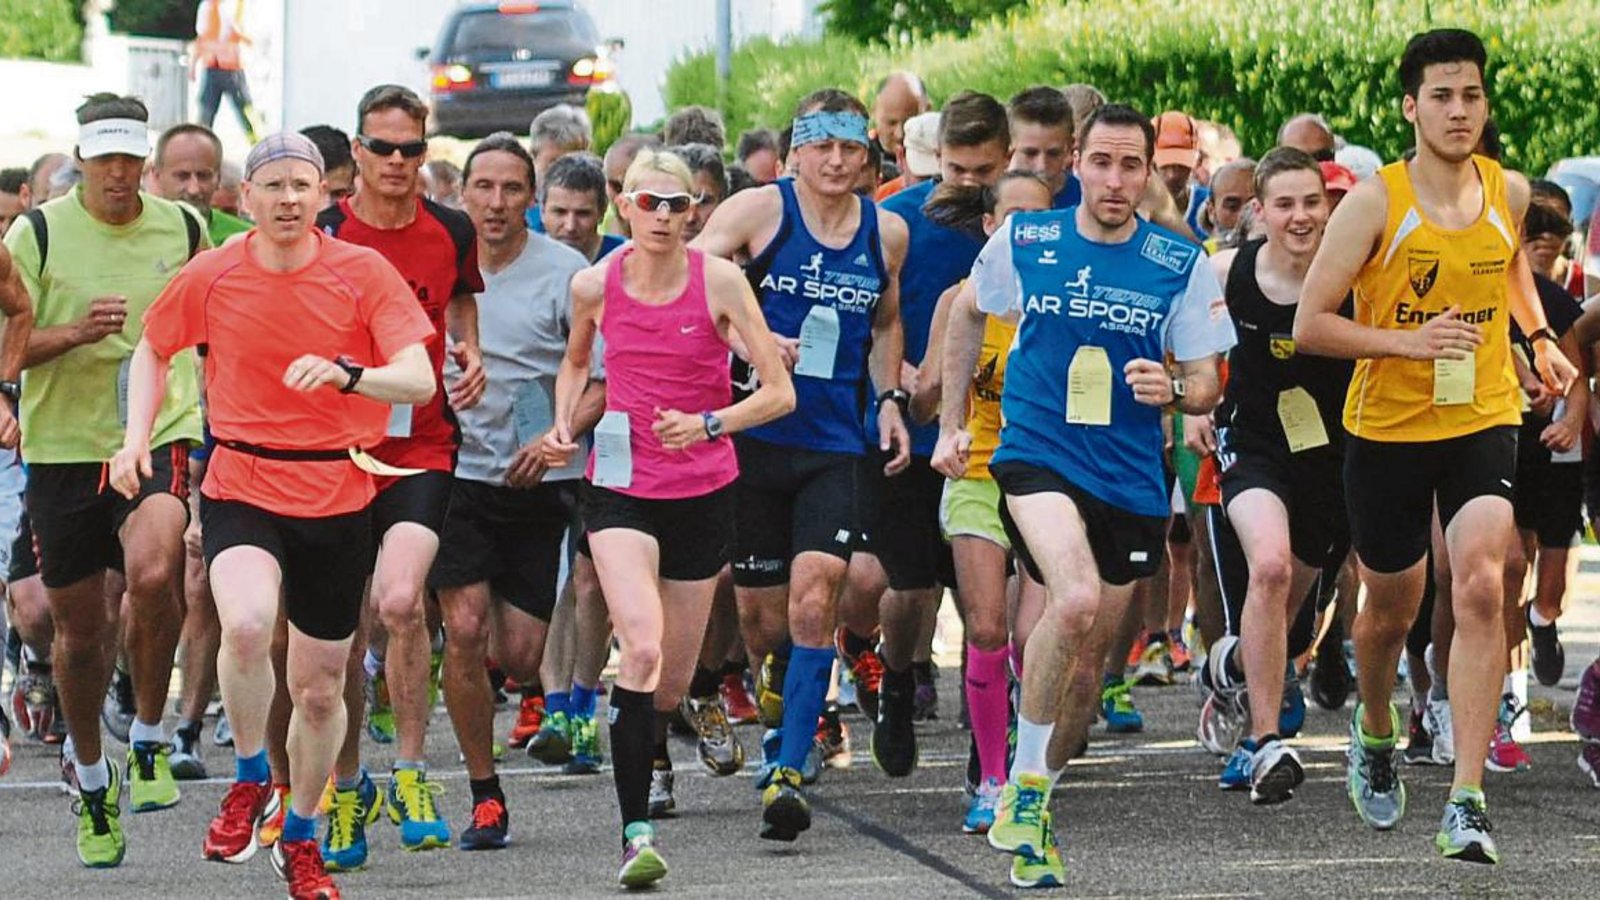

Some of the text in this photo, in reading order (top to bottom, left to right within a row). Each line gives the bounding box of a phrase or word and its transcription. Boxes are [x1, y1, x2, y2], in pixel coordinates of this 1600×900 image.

[1015, 223, 1060, 241] HESS
[759, 273, 881, 309] AR SPORT
[1092, 285, 1163, 311] TEAM
[1026, 294, 1164, 330] AR SPORT
[1395, 302, 1497, 324] Enger
